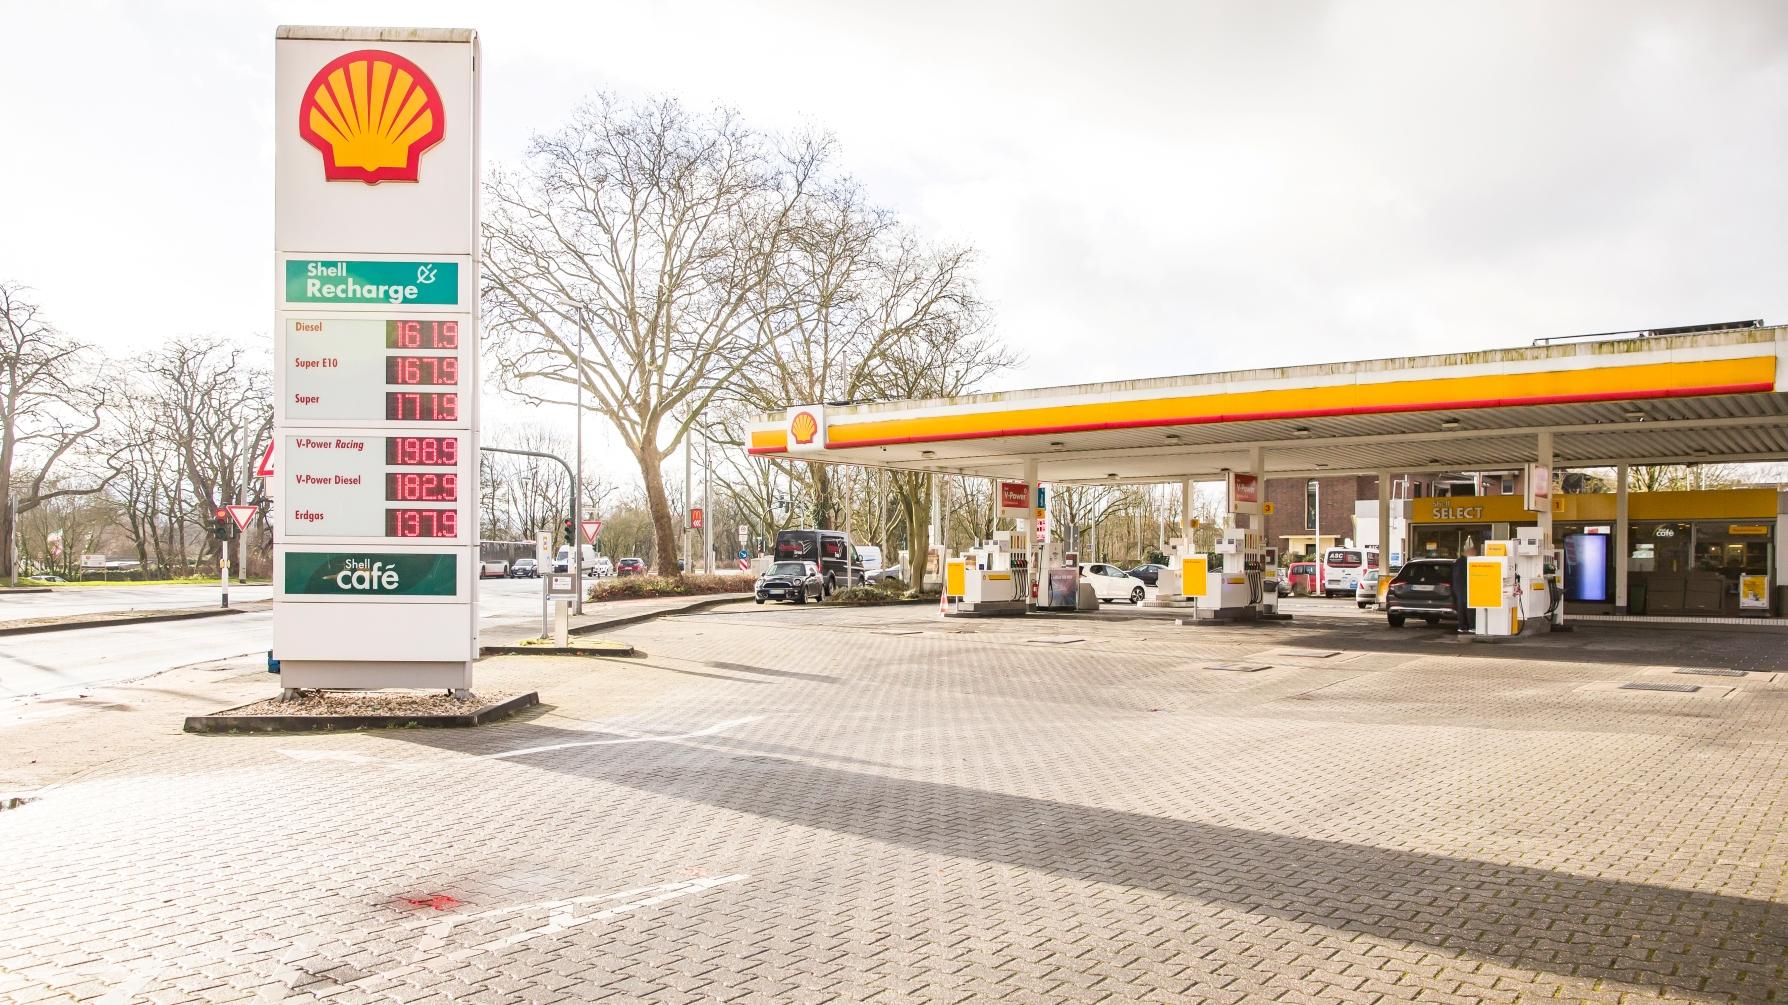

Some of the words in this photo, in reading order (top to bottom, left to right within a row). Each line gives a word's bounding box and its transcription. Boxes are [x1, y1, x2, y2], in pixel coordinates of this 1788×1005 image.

[307, 262, 347, 277] Shell
[306, 278, 419, 304] Recharge
[295, 321, 323, 332] Diesel
[295, 358, 320, 369] Super
[322, 358, 338, 368] E10
[295, 394, 320, 405] Super
[296, 438, 332, 449] V-Power
[335, 439, 364, 452] Racing
[296, 474, 332, 485] V-Power
[334, 475, 361, 485] Diesel
[295, 510, 324, 522] Erdgas
[1432, 507, 1483, 519] SELECT
[345, 559, 370, 569] Shell
[336, 562, 399, 590] café
